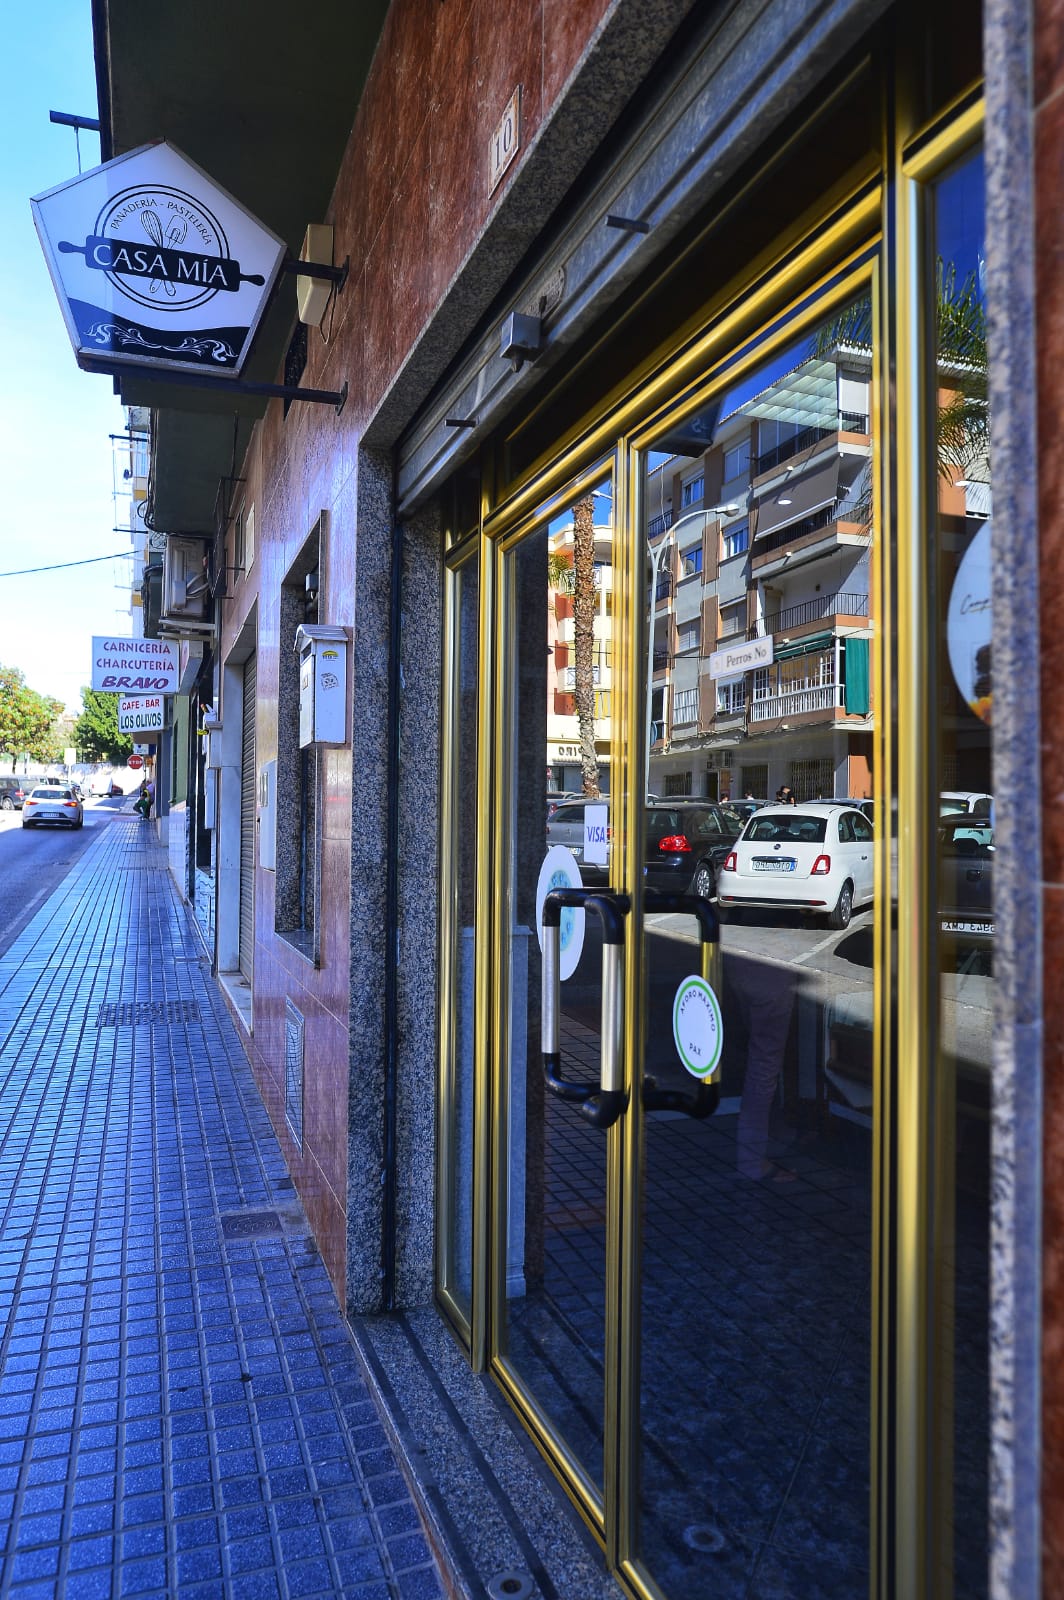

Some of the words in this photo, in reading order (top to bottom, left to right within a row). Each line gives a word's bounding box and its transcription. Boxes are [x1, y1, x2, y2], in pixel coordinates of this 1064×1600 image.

[495, 118, 512, 170] 10
[110, 196, 158, 230] PANADERÍA
[167, 201, 212, 246] PASTELERÍA
[93, 244, 168, 277] CASA
[177, 258, 228, 287] MÍA
[103, 641, 171, 654] CARNICERÍA
[96, 658, 174, 671] CHARCUTERÍA
[726, 652, 752, 668] Perros
[754, 645, 767, 660] No
[101, 675, 169, 690] BRAVO
[121, 700, 140, 711] CAFE
[145, 698, 160, 708] BAR
[120, 714, 134, 730] LOS
[136, 712, 162, 728] OLIVOS
[586, 826, 605, 843] VISA
[689, 1042, 701, 1056] PAX
